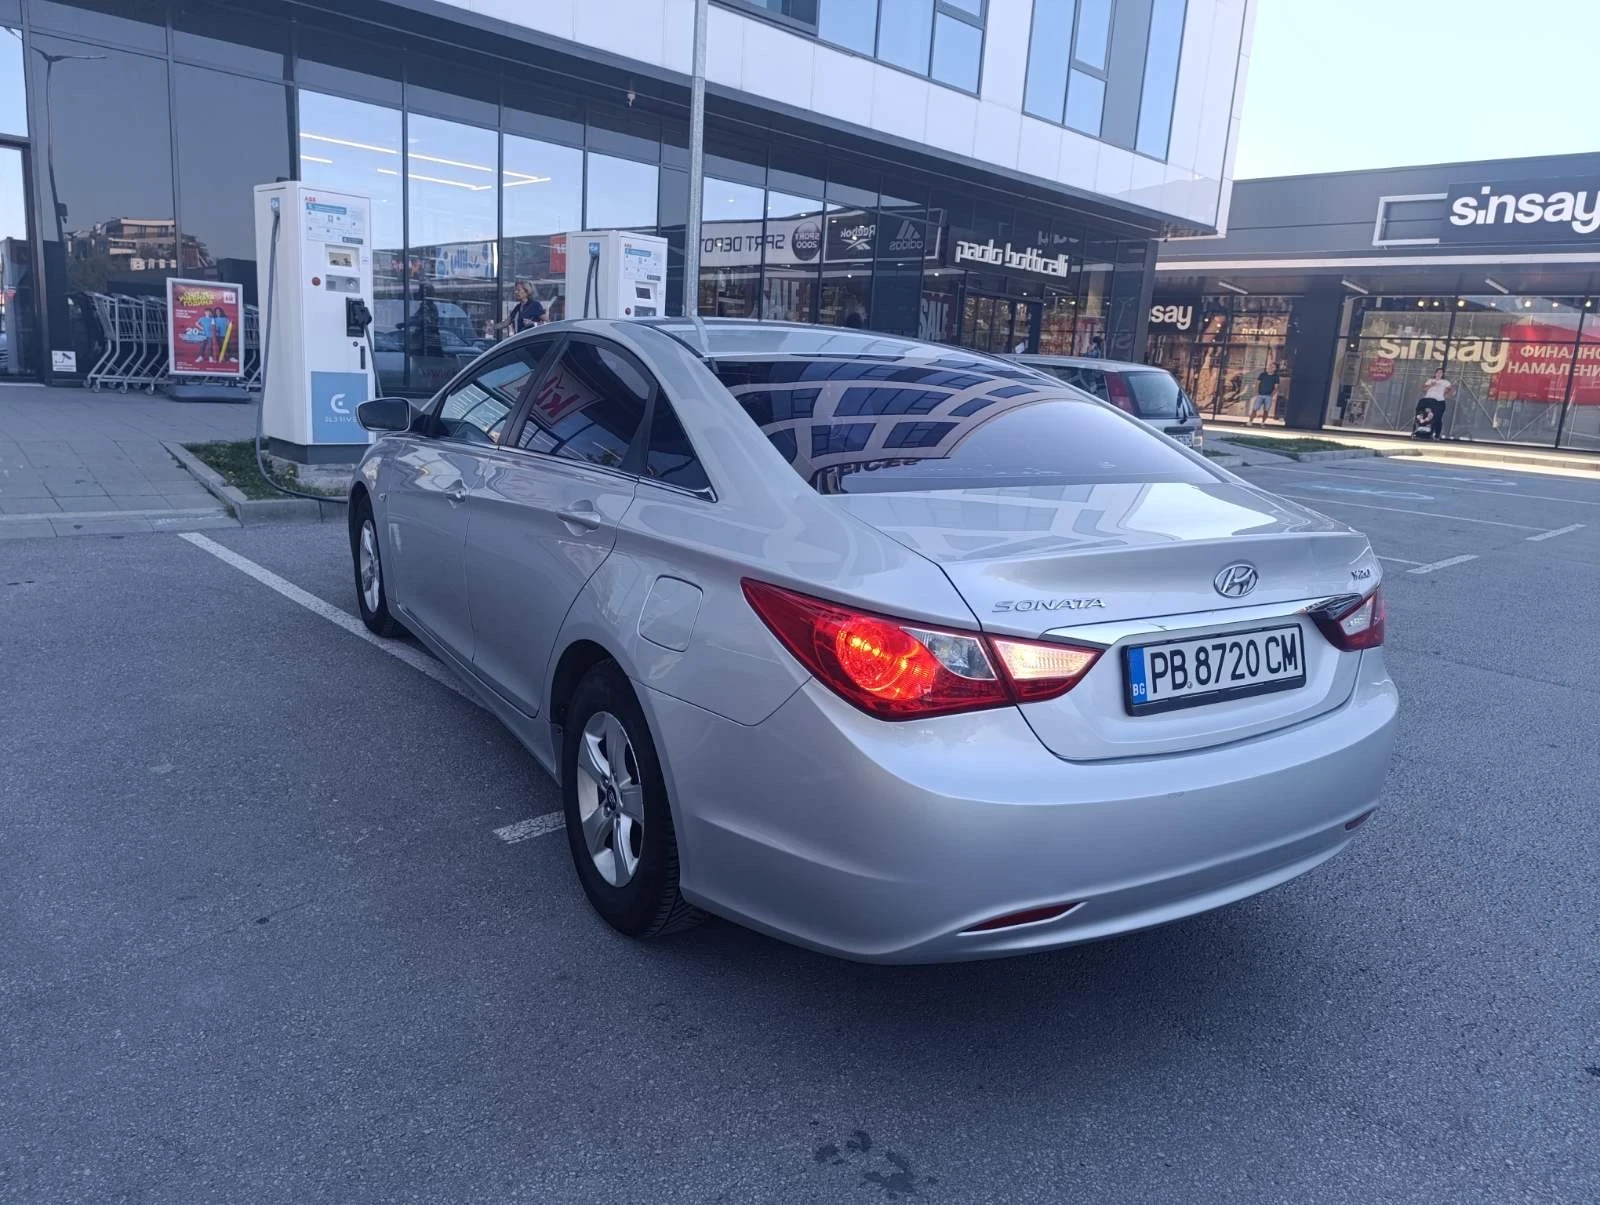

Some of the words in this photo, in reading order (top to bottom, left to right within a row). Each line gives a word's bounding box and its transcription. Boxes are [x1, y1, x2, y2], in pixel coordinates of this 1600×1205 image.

[1450, 186, 1600, 234] sinsay
[1148, 305, 1193, 330] say
[1377, 334, 1510, 373] sinsay
[992, 598, 1105, 613] SONATA
[1150, 649, 1188, 694] PB
[1195, 639, 1260, 686] 8720
[1265, 632, 1299, 674] CM
[1132, 683, 1146, 696] BG
